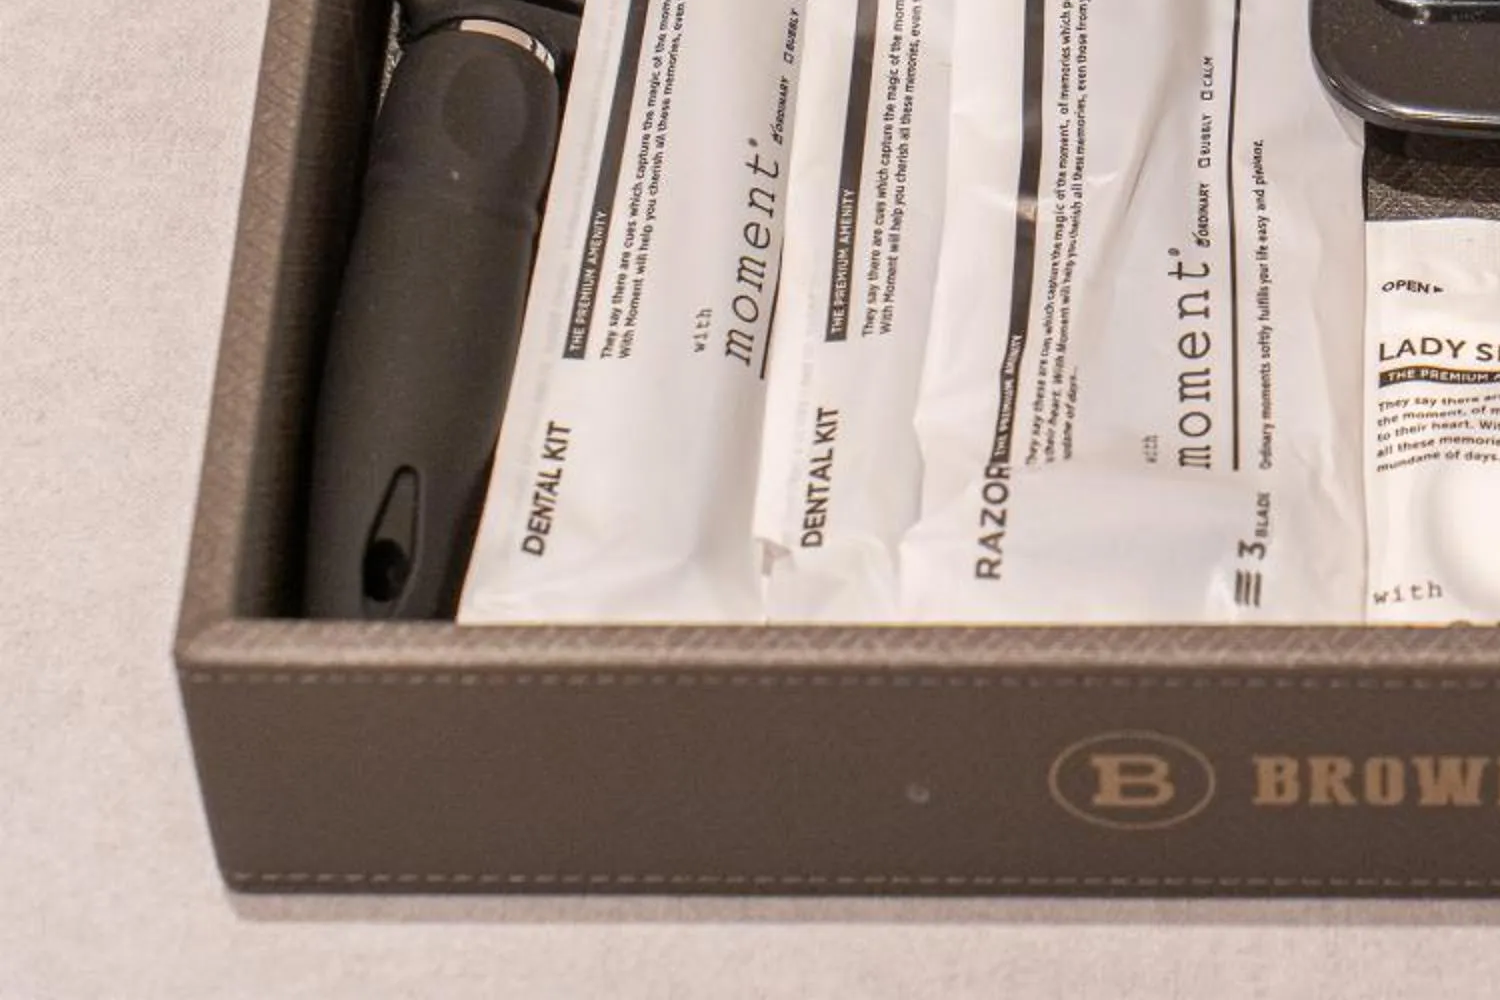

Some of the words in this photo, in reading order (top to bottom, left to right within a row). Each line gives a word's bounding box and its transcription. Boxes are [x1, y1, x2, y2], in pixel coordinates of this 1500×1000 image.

[910, 5, 921, 37] even
[890, 34, 902, 52] the
[888, 53, 900, 66] of
[905, 39, 920, 92] memories,
[887, 68, 900, 101] magic
[882, 103, 895, 121] the
[899, 95, 913, 125] these
[880, 123, 893, 166] capture
[899, 127, 910, 140] all
[894, 143, 908, 183] cherish
[875, 167, 889, 199] which
[894, 185, 906, 206] you
[839, 189, 854, 244] AMENITY
[874, 201, 886, 226] cues
[889, 207, 904, 231] help
[872, 228, 883, 247] are
[888, 233, 900, 253] will
[725, 153, 780, 367] moment
[867, 249, 881, 281] there
[833, 248, 848, 306] PREMIUM
[883, 255, 898, 303] Moment
[1382, 279, 1430, 295] OPEN
[867, 283, 880, 304] say
[830, 310, 844, 333] THE
[861, 307, 877, 337] They
[879, 305, 893, 334] With
[1379, 337, 1467, 362] LADY
[1168, 261, 1212, 470] moment
[1388, 369, 1415, 381] THE
[1420, 369, 1488, 382] PREMIUM
[541, 420, 573, 463] KIT
[814, 407, 840, 445] KIT
[520, 468, 563, 558] DENTAL
[800, 446, 834, 549] DENTAL
[974, 464, 1011, 580] RAZOR
[1238, 540, 1266, 560] 3
[1254, 491, 1271, 538] BLADE
[1373, 580, 1443, 605] with
